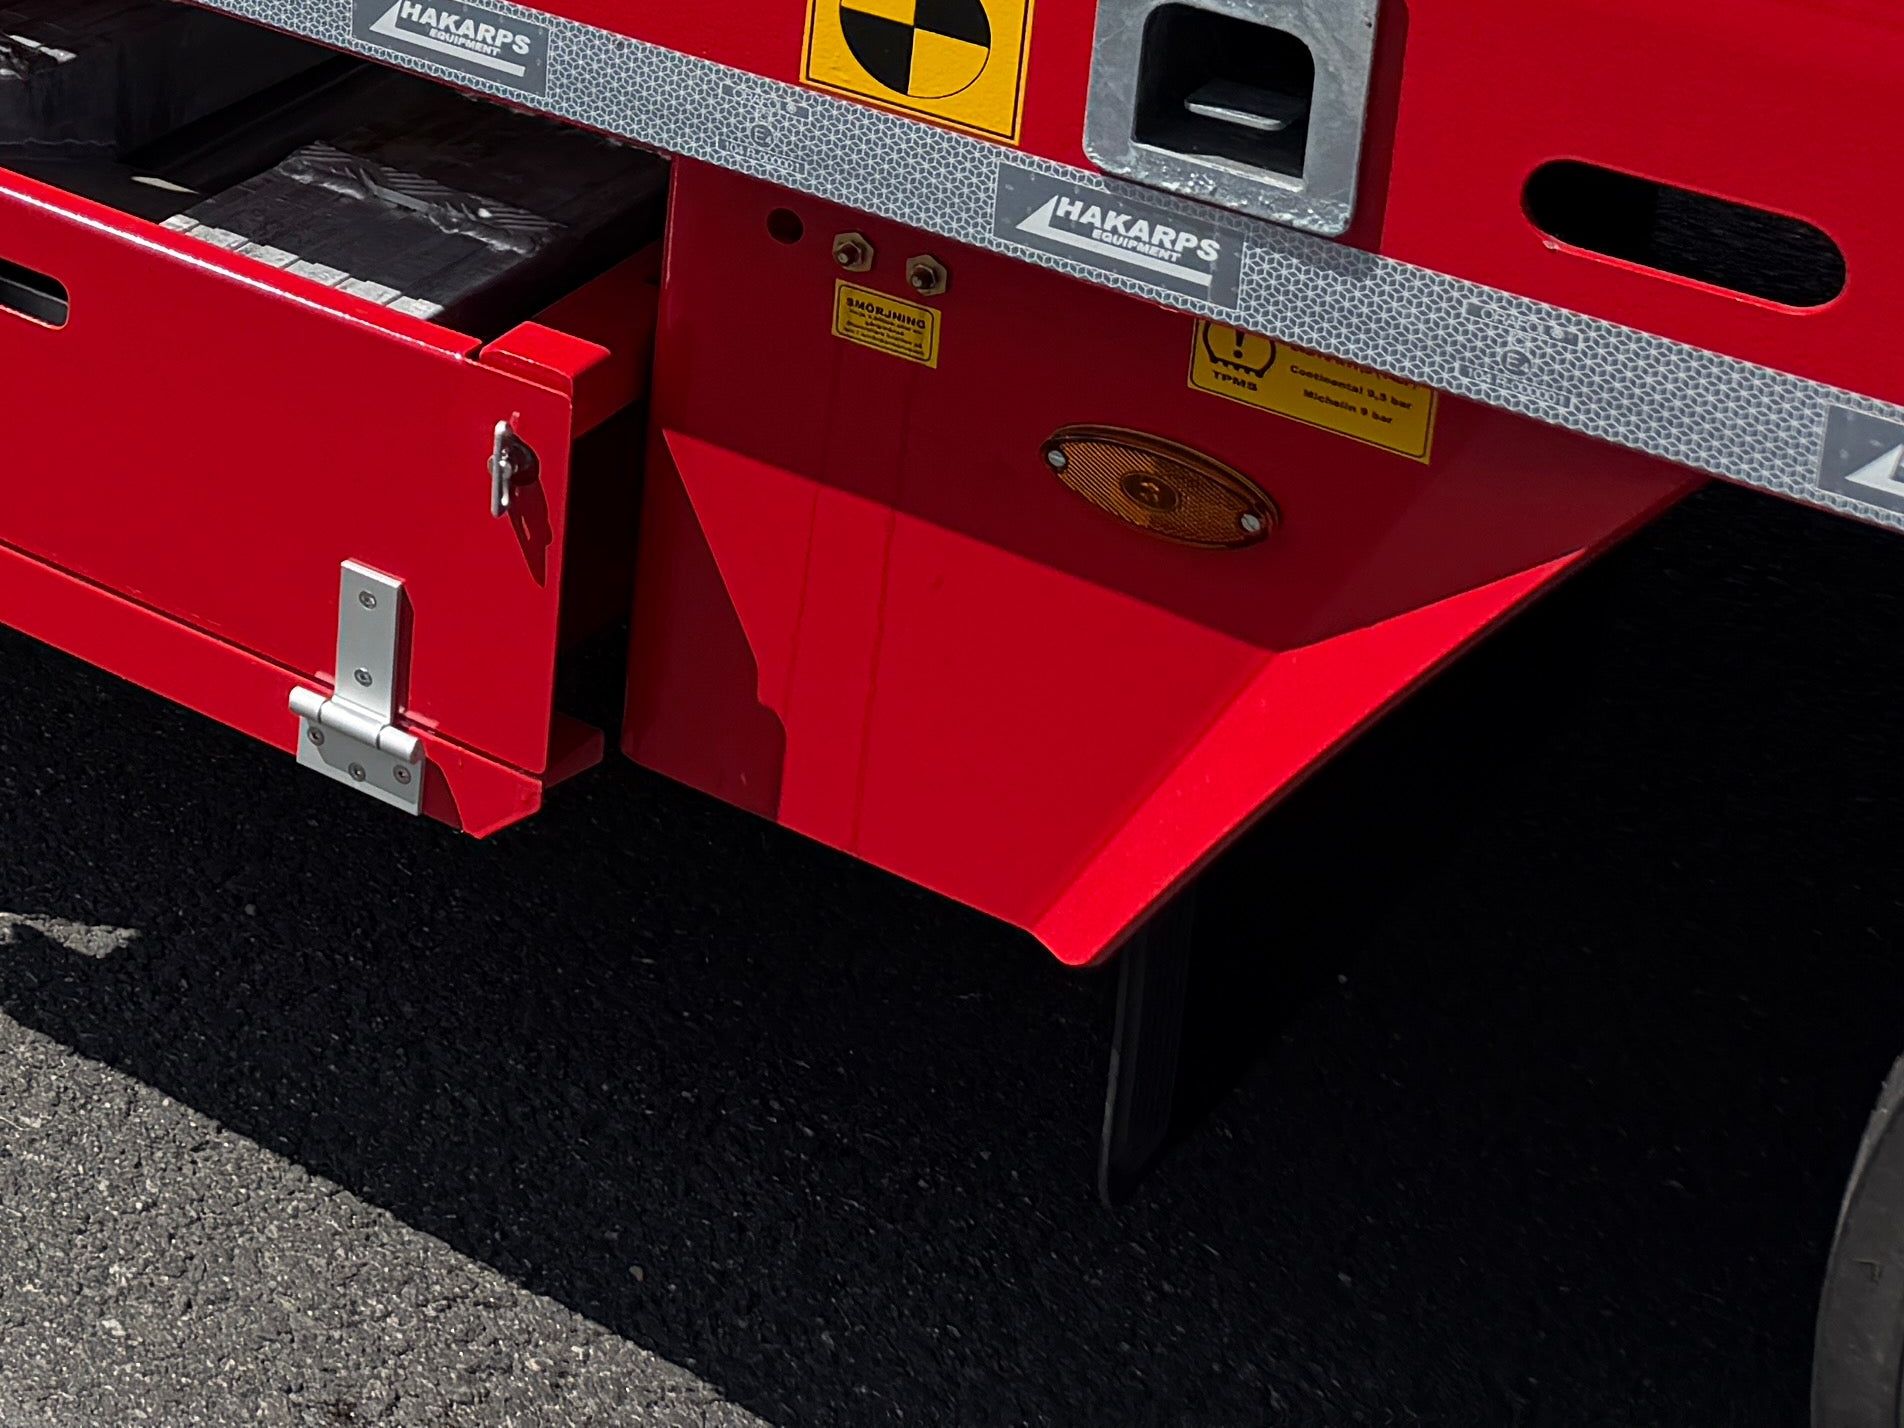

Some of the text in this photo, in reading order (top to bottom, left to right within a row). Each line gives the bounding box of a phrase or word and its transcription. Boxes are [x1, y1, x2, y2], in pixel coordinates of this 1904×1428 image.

[400, 0, 532, 55] HAKARPS
[428, 27, 502, 57] EQUIPMENT
[1055, 196, 1221, 262] HAKARPS
[1091, 228, 1182, 263] EQUIPMENT
[1211, 369, 1259, 393] TPMS
[1289, 364, 1364, 395] Continental
[1390, 394, 1413, 411] bar
[1303, 389, 1358, 414] Michelin
[1371, 409, 1393, 425] bar
